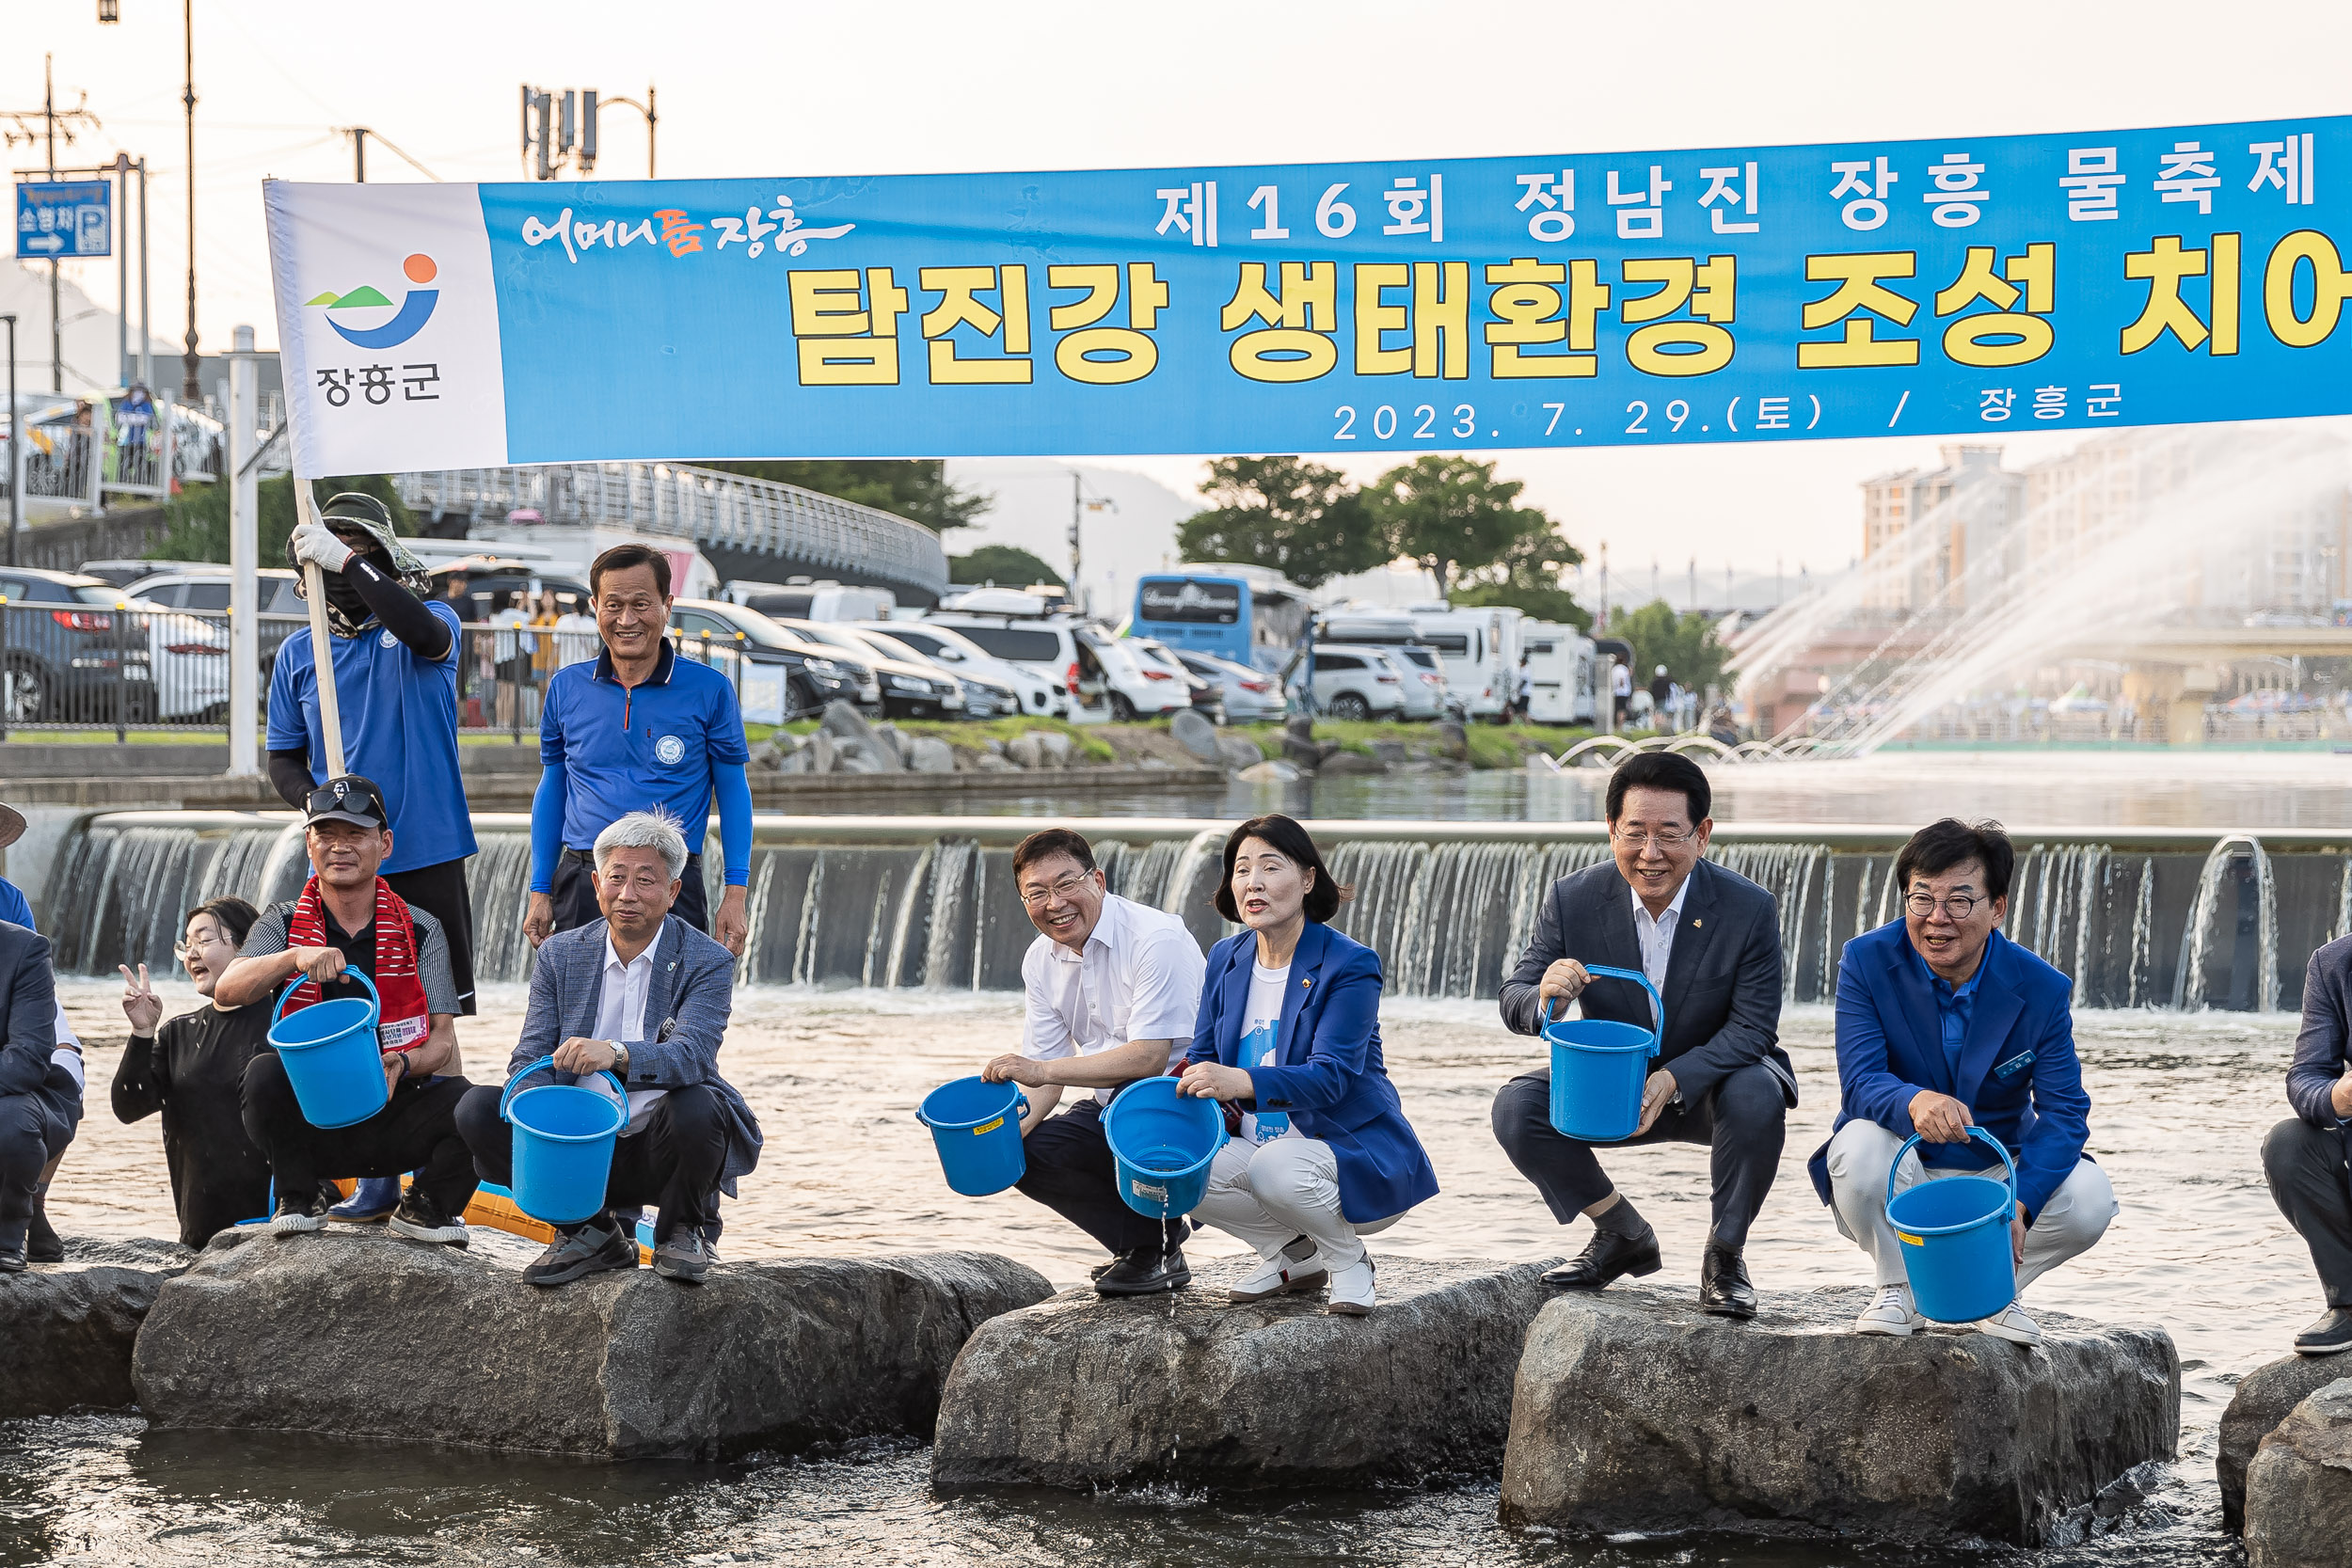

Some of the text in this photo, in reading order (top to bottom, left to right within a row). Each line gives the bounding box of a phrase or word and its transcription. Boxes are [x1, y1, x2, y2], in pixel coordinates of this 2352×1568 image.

[1154, 132, 2315, 248] 제16회 정남진 장흥 물축제
[787, 262, 1169, 387] 탐진강
[1220, 257, 1739, 384] 생태환경
[1796, 242, 2057, 370] 조성
[316, 363, 440, 407] 장흥군
[1333, 404, 1500, 440] 2023.
[1542, 403, 1582, 436] 7.
[1979, 383, 2122, 422] 장흥군
